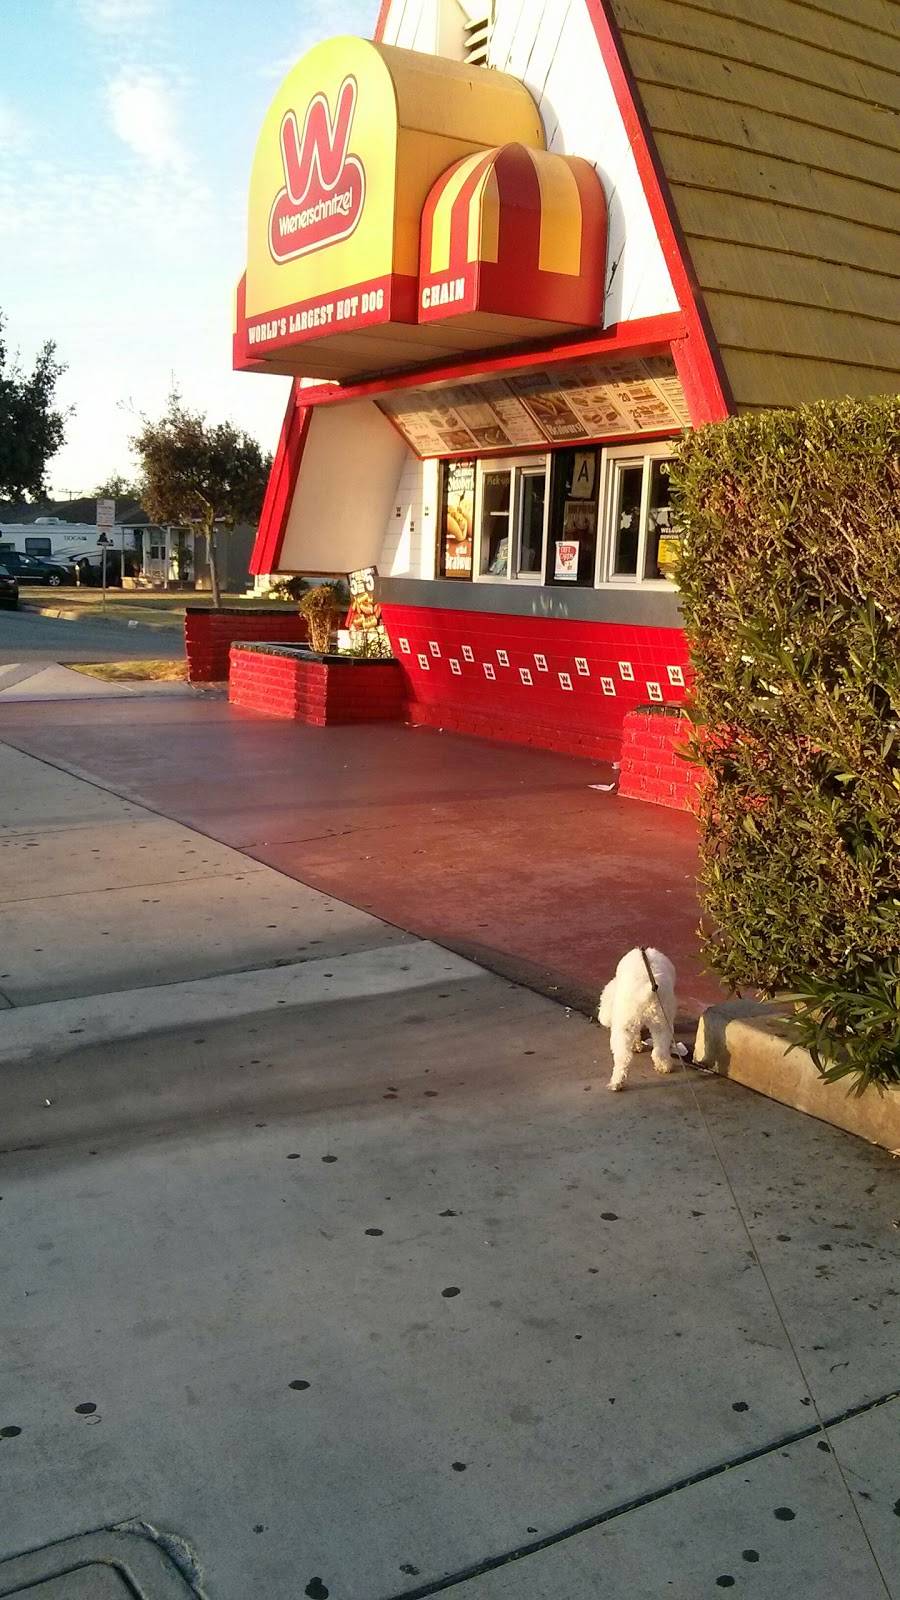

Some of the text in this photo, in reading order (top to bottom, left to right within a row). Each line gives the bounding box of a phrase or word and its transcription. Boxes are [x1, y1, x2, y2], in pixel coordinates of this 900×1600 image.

[281, 76, 357, 203] W
[278, 187, 353, 237] Wienerschnitzel
[248, 277, 465, 344] WORLD'S LARGEST HOT DOG CHAIN
[577, 460, 589, 482] A
